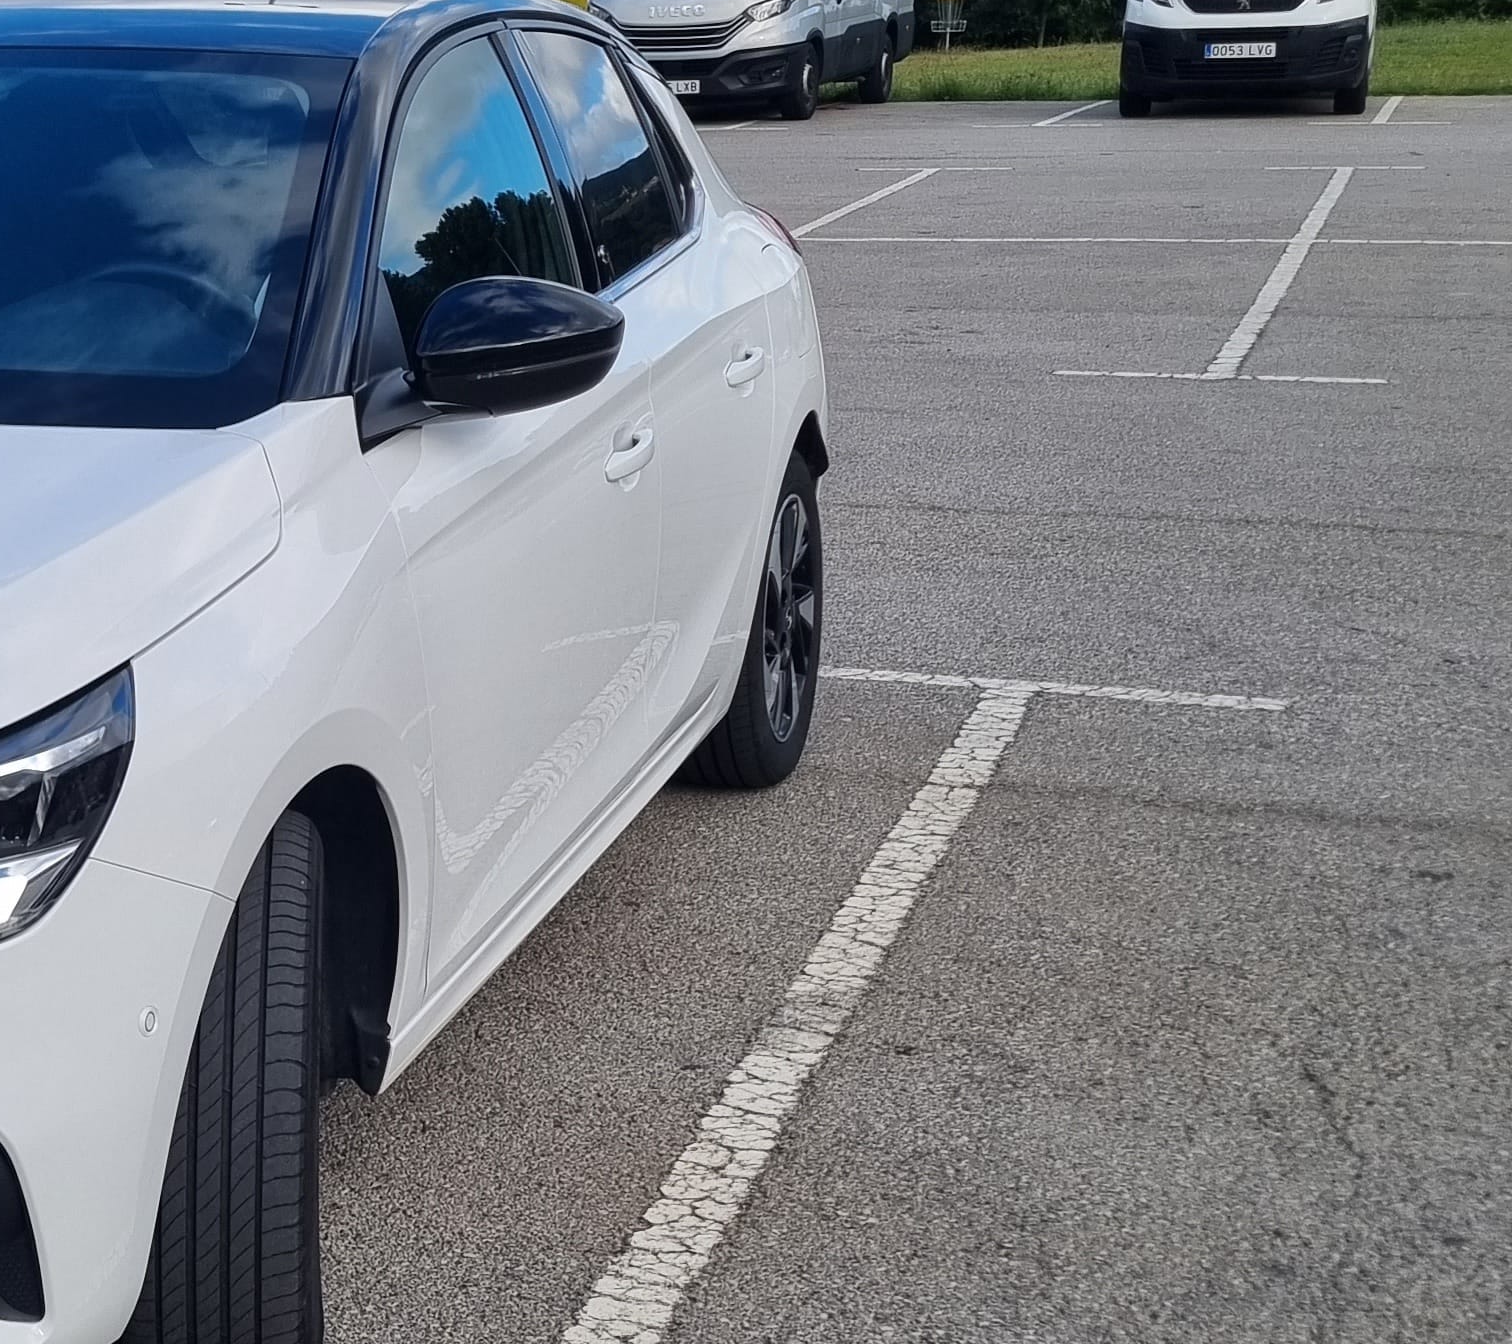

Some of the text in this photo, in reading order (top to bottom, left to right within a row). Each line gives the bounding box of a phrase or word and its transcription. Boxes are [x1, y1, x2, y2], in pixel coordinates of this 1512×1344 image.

[649, 4, 705, 18] IVECO
[1212, 44, 1273, 57] 0053 LVG
